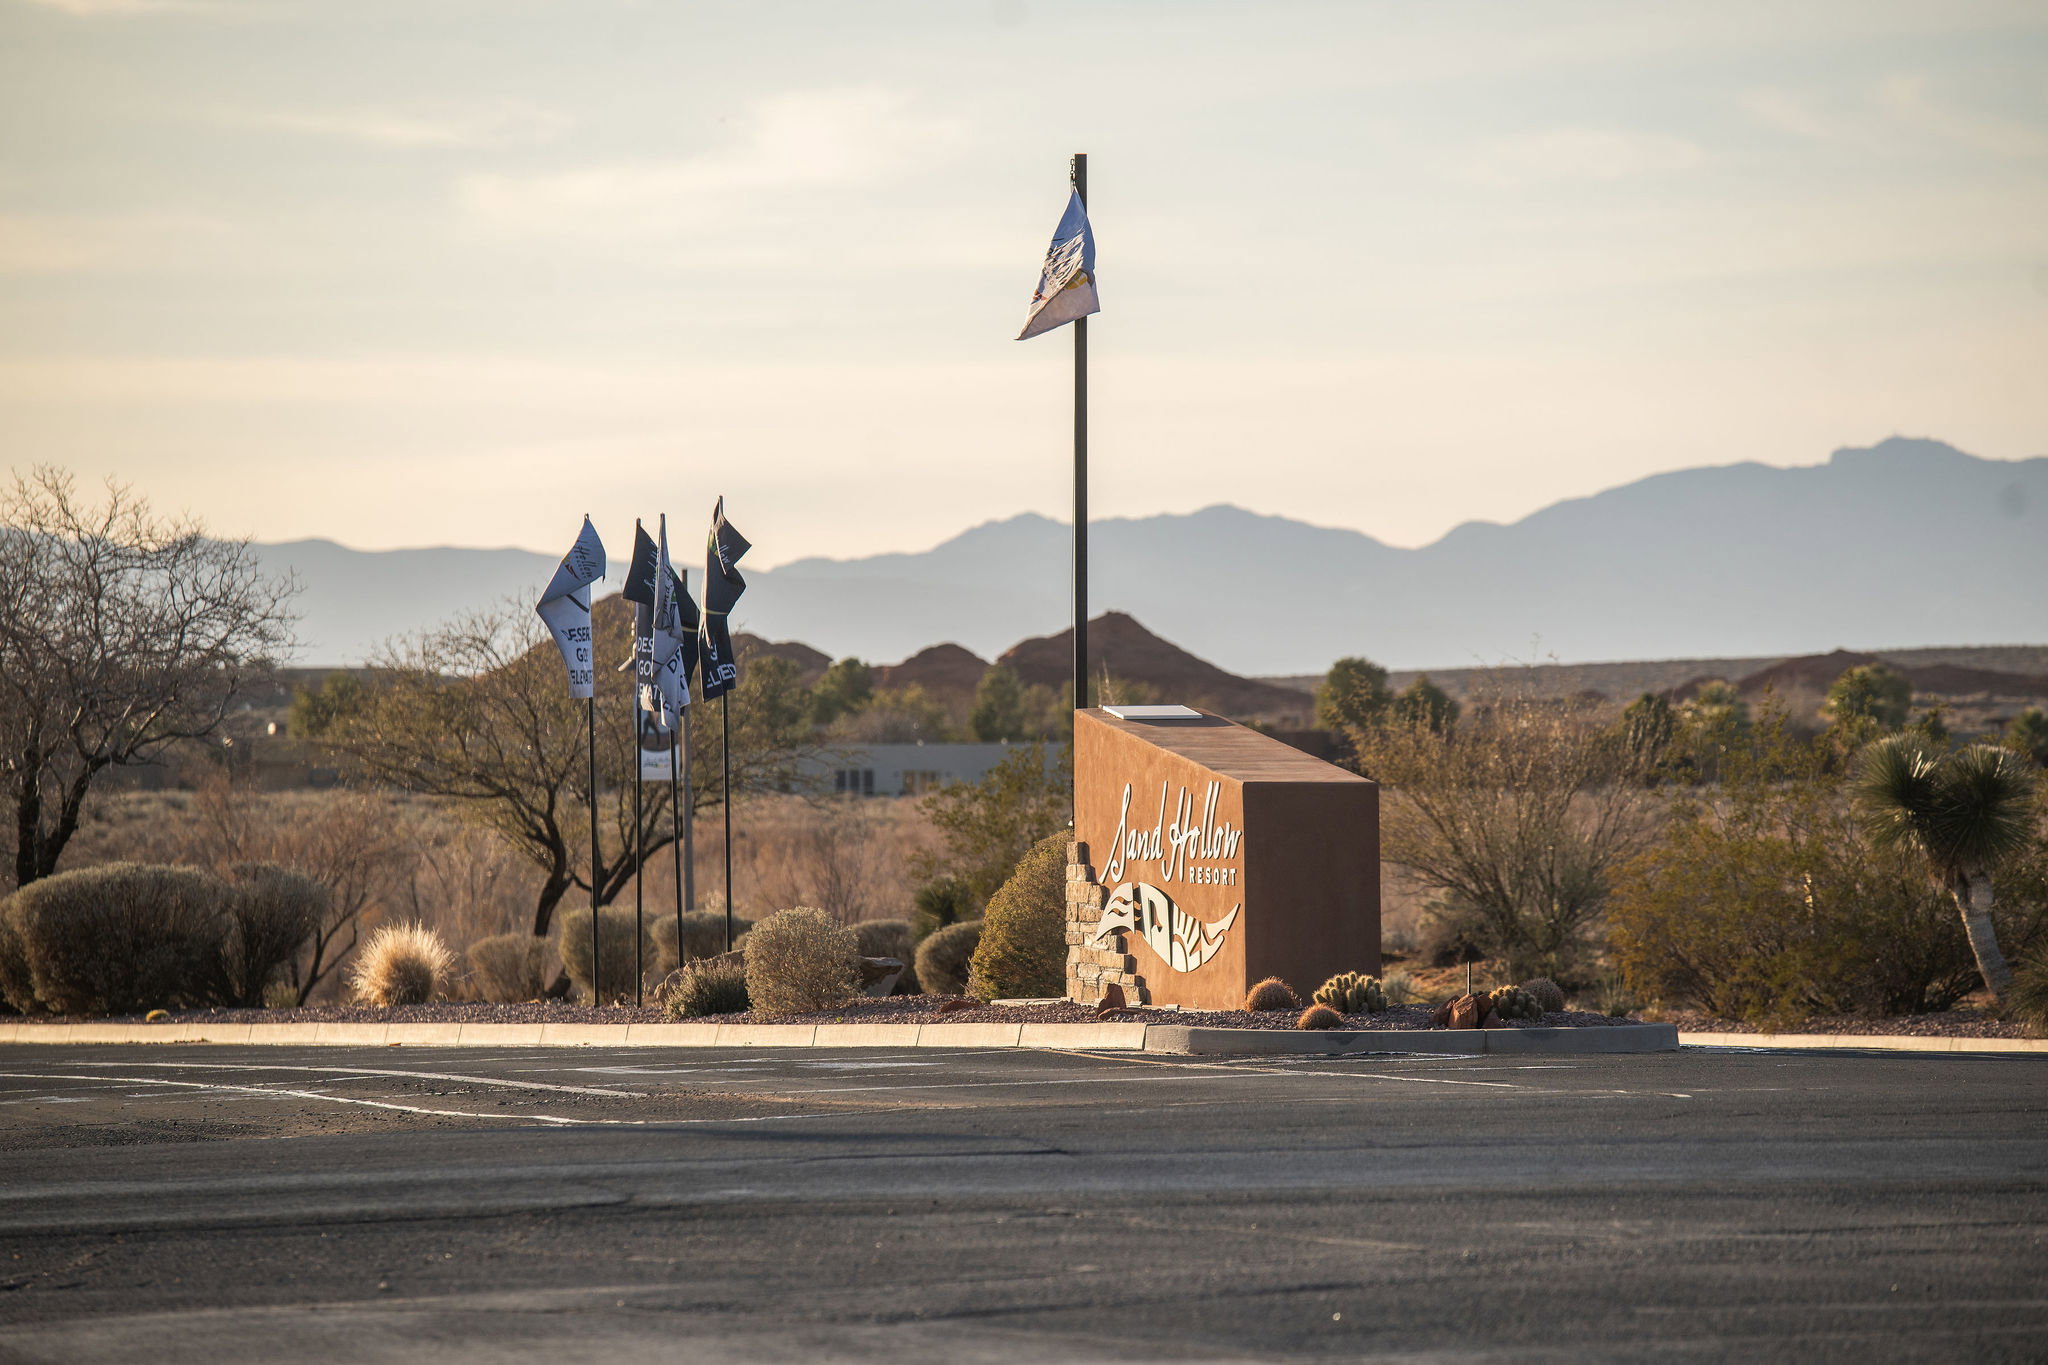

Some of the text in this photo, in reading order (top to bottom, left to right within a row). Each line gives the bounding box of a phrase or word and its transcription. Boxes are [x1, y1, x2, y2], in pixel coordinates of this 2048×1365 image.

[561, 626, 592, 643] DESER
[1099, 780, 1243, 884] Sand Hollow
[1189, 866, 1238, 886] RESORT
